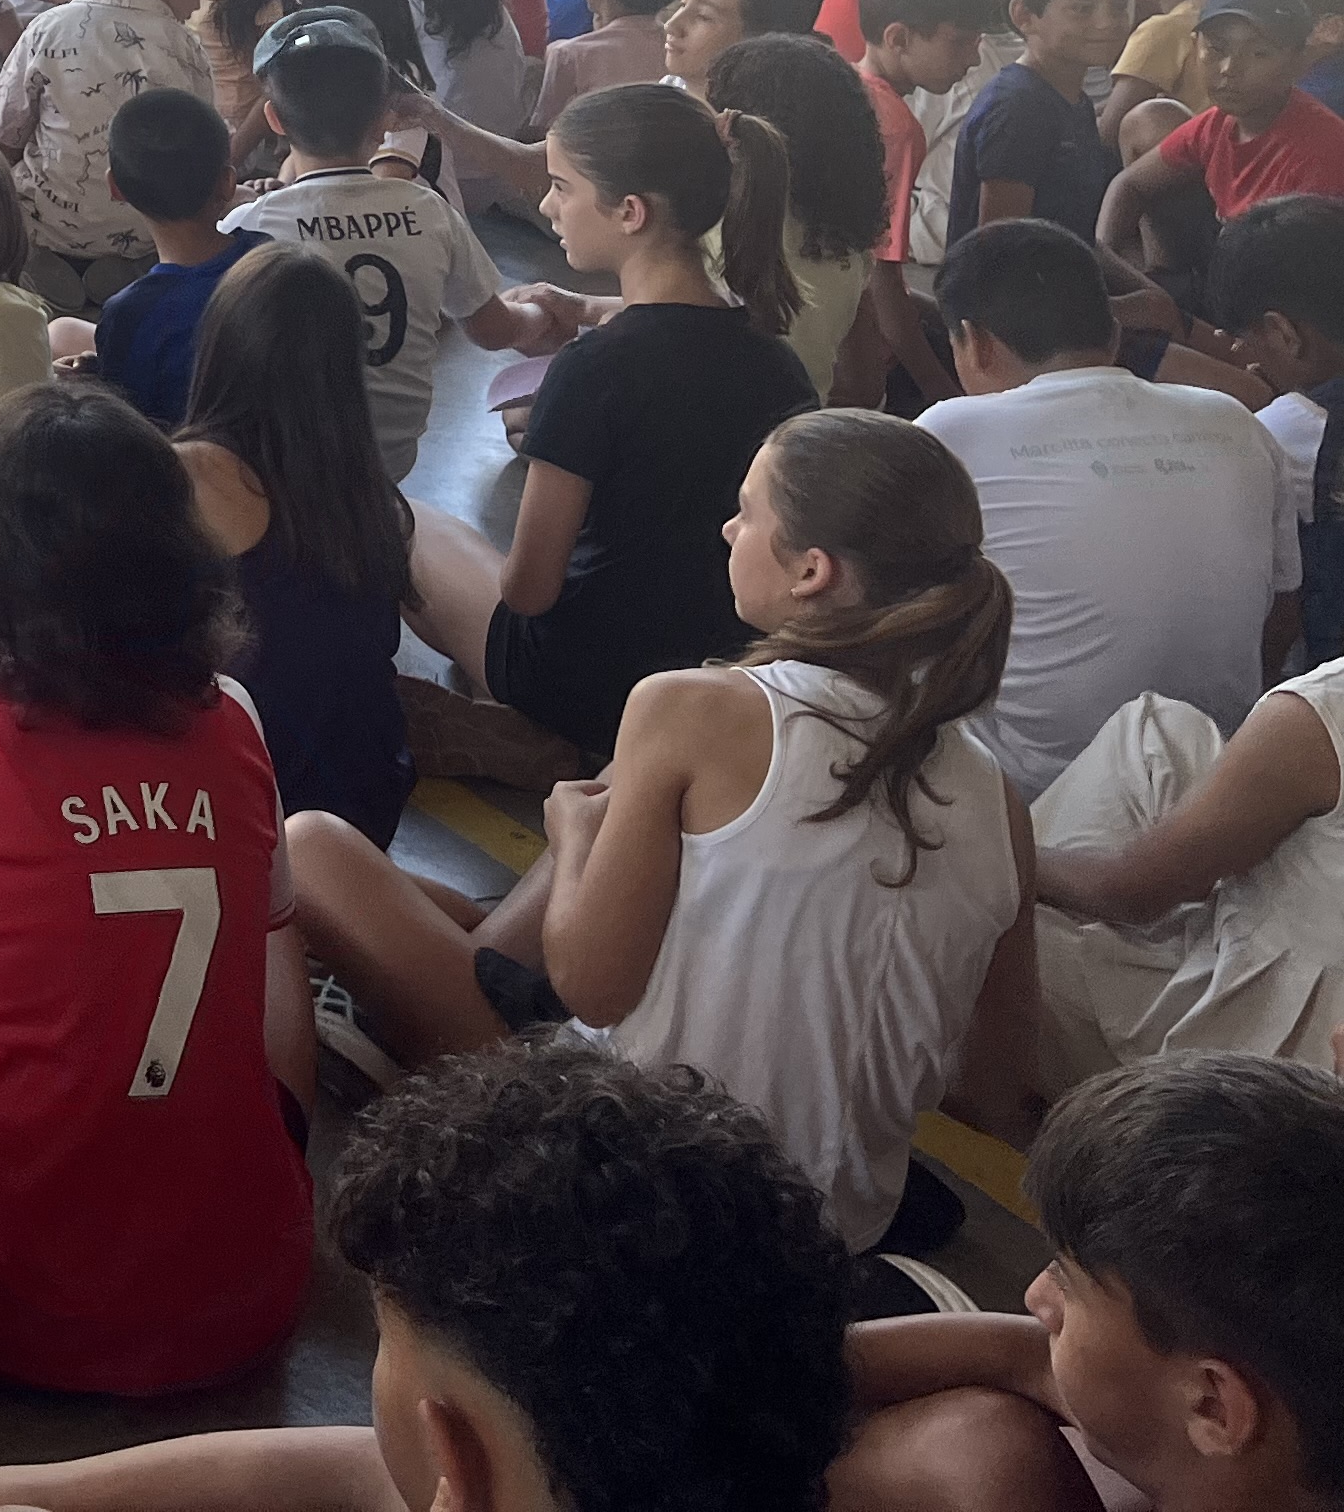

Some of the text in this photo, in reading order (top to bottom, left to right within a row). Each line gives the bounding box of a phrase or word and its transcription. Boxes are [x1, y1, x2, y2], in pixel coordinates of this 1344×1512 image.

[296, 205, 423, 241] MBAPPÉ
[344, 253, 408, 367] 9
[61, 782, 216, 845] SAKA
[89, 867, 221, 1097] 7
